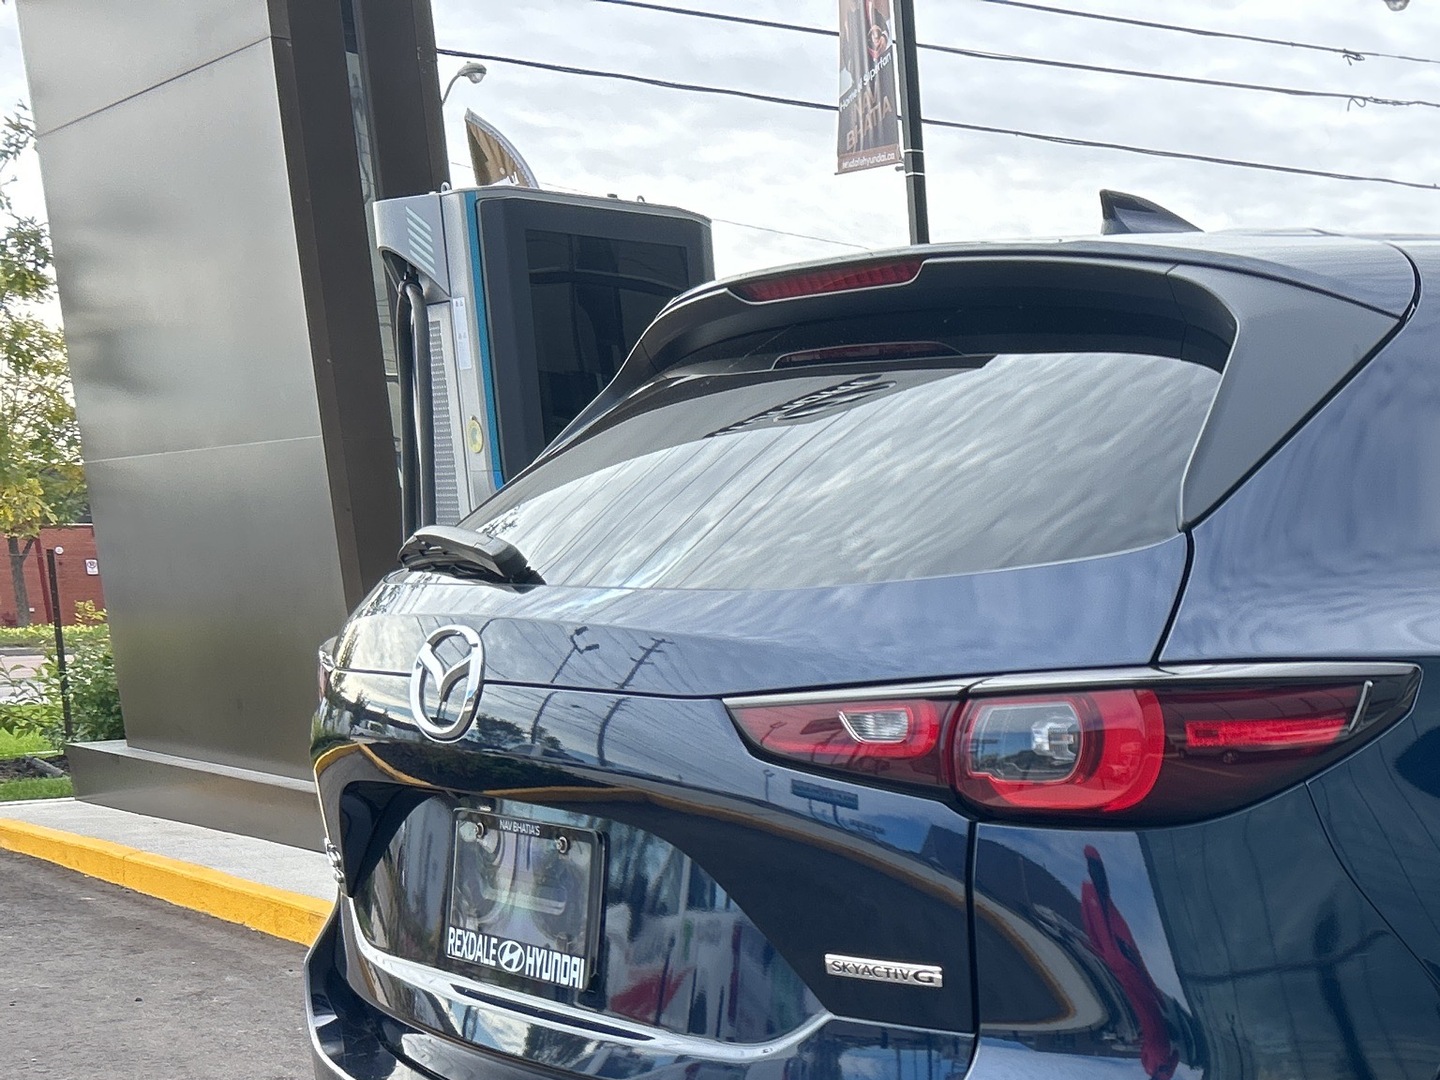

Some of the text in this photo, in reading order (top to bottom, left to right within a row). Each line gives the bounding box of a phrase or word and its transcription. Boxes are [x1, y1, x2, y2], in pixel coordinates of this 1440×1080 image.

[499, 819, 541, 837] NAV BHATIA'S
[447, 926, 585, 990] REXDALE HYUNDAI
